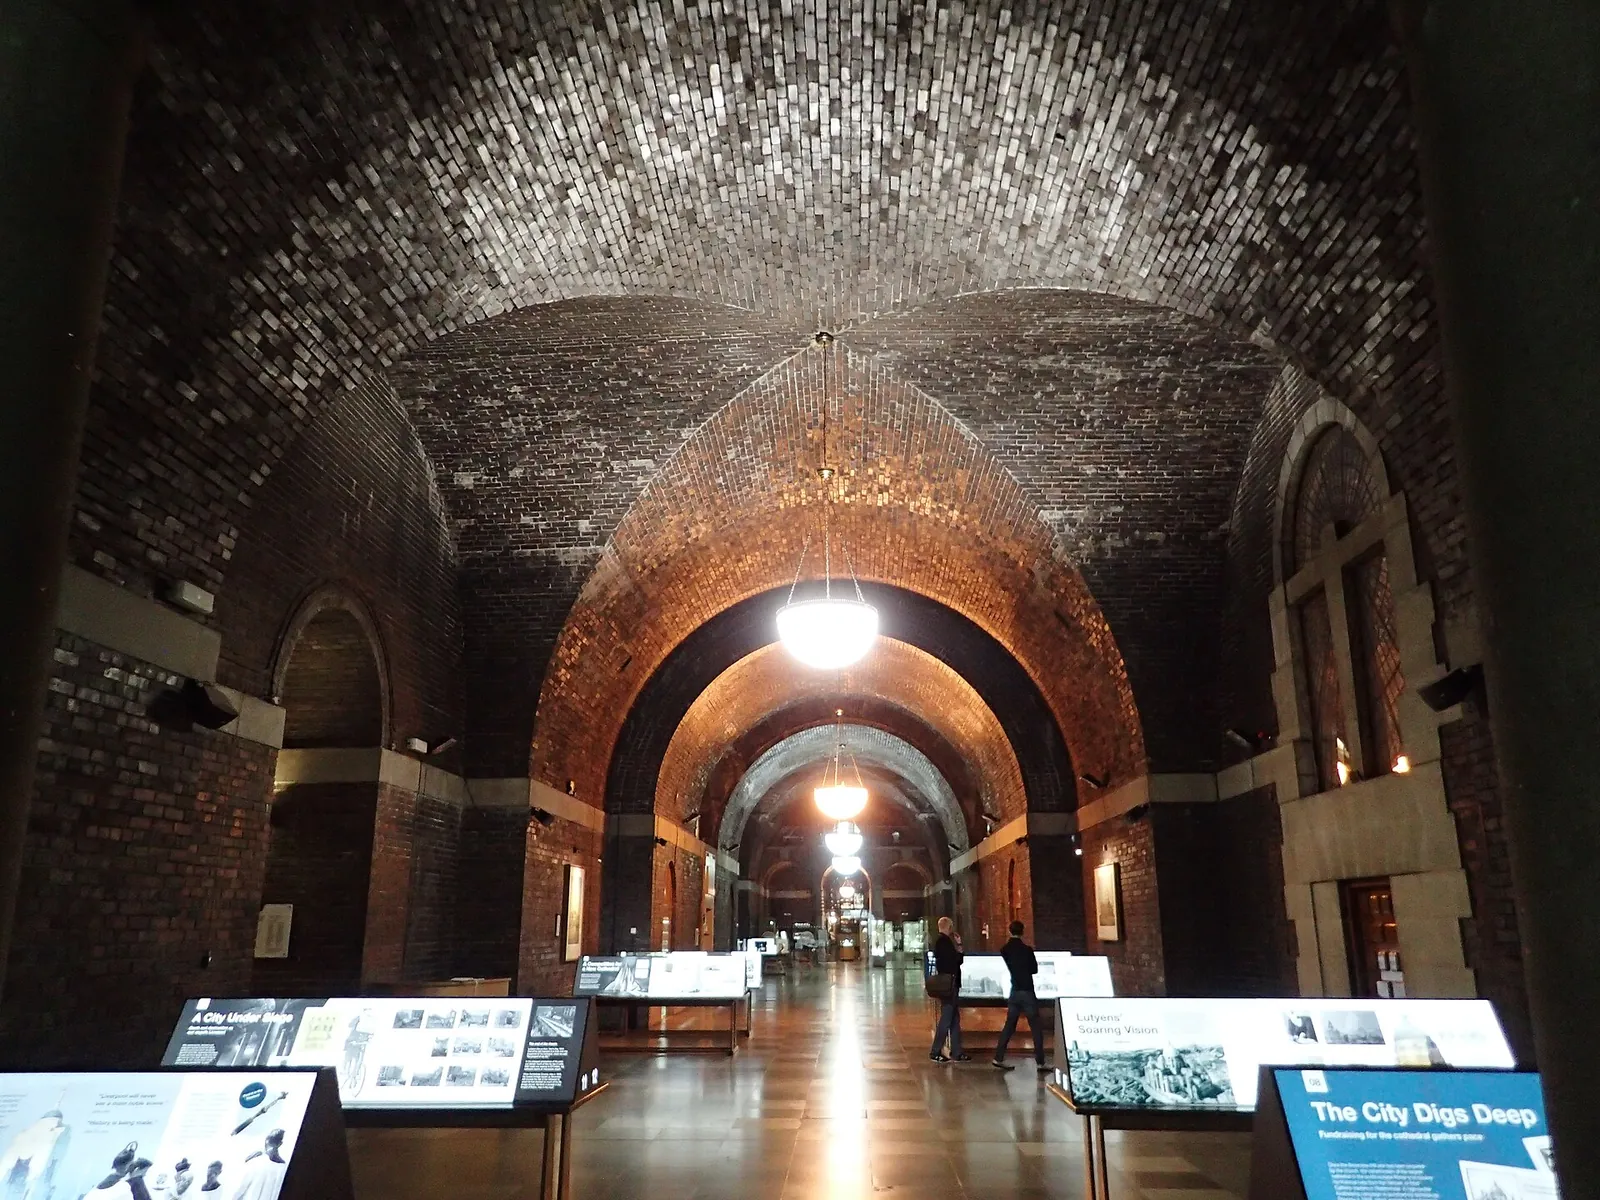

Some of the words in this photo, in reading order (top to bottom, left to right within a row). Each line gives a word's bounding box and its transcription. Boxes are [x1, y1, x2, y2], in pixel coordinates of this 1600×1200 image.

[191, 1012, 202, 1023] A
[203, 1012, 227, 1026] City
[226, 1012, 262, 1023] Under
[262, 1012, 294, 1025] Siege
[1076, 1013, 1122, 1023] Lutyens'
[1078, 1025, 1121, 1036] Soaring
[1124, 1025, 1159, 1034] Vision
[1310, 1101, 1358, 1122] The
[1362, 1101, 1408, 1127] City
[1412, 1102, 1469, 1128] Digs
[1471, 1103, 1538, 1129] Deep
[1318, 1130, 1366, 1141] Fundraising
[1365, 1131, 1378, 1139] for
[1378, 1131, 1393, 1140] the
[1393, 1131, 1431, 1140] cathedral
[1431, 1132, 1462, 1142] gathers
